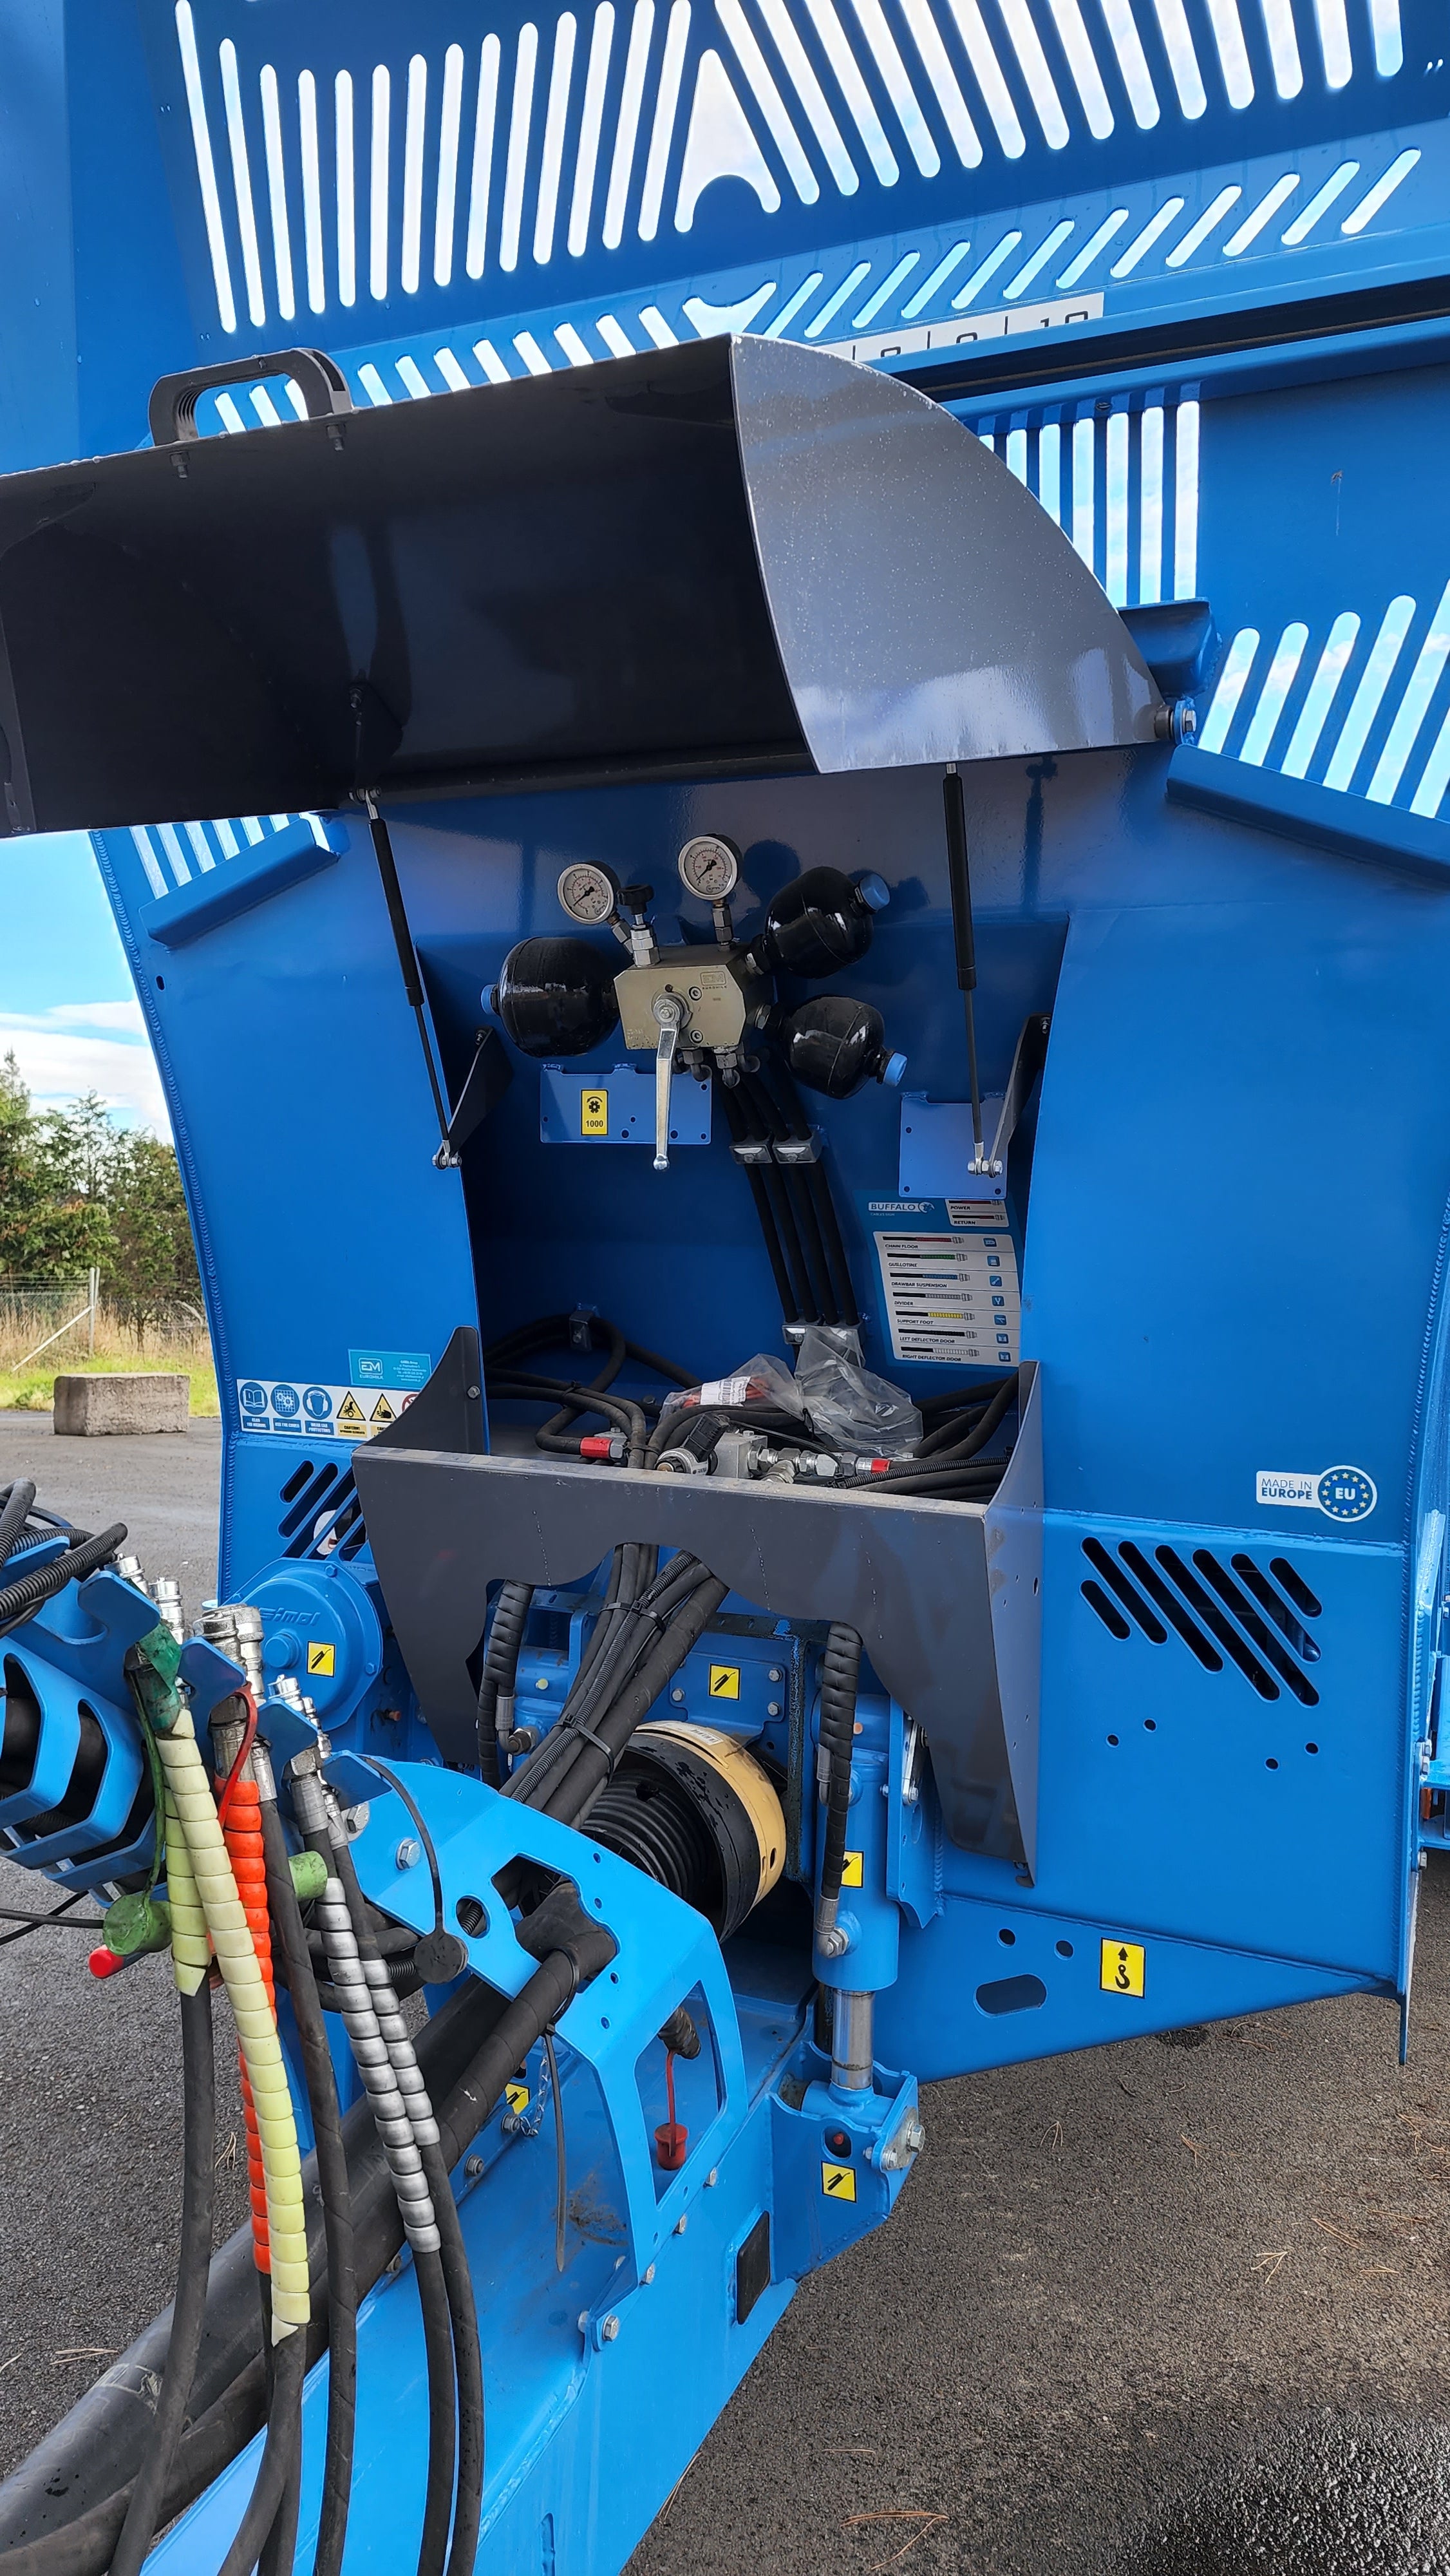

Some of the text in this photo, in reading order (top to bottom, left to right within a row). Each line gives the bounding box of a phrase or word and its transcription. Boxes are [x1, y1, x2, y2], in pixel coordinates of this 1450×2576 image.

[1261, 1478, 1312, 1490] MADE IN
[1261, 1488, 1312, 1500] EUROPE
[1335, 1487, 1356, 1500] EU
